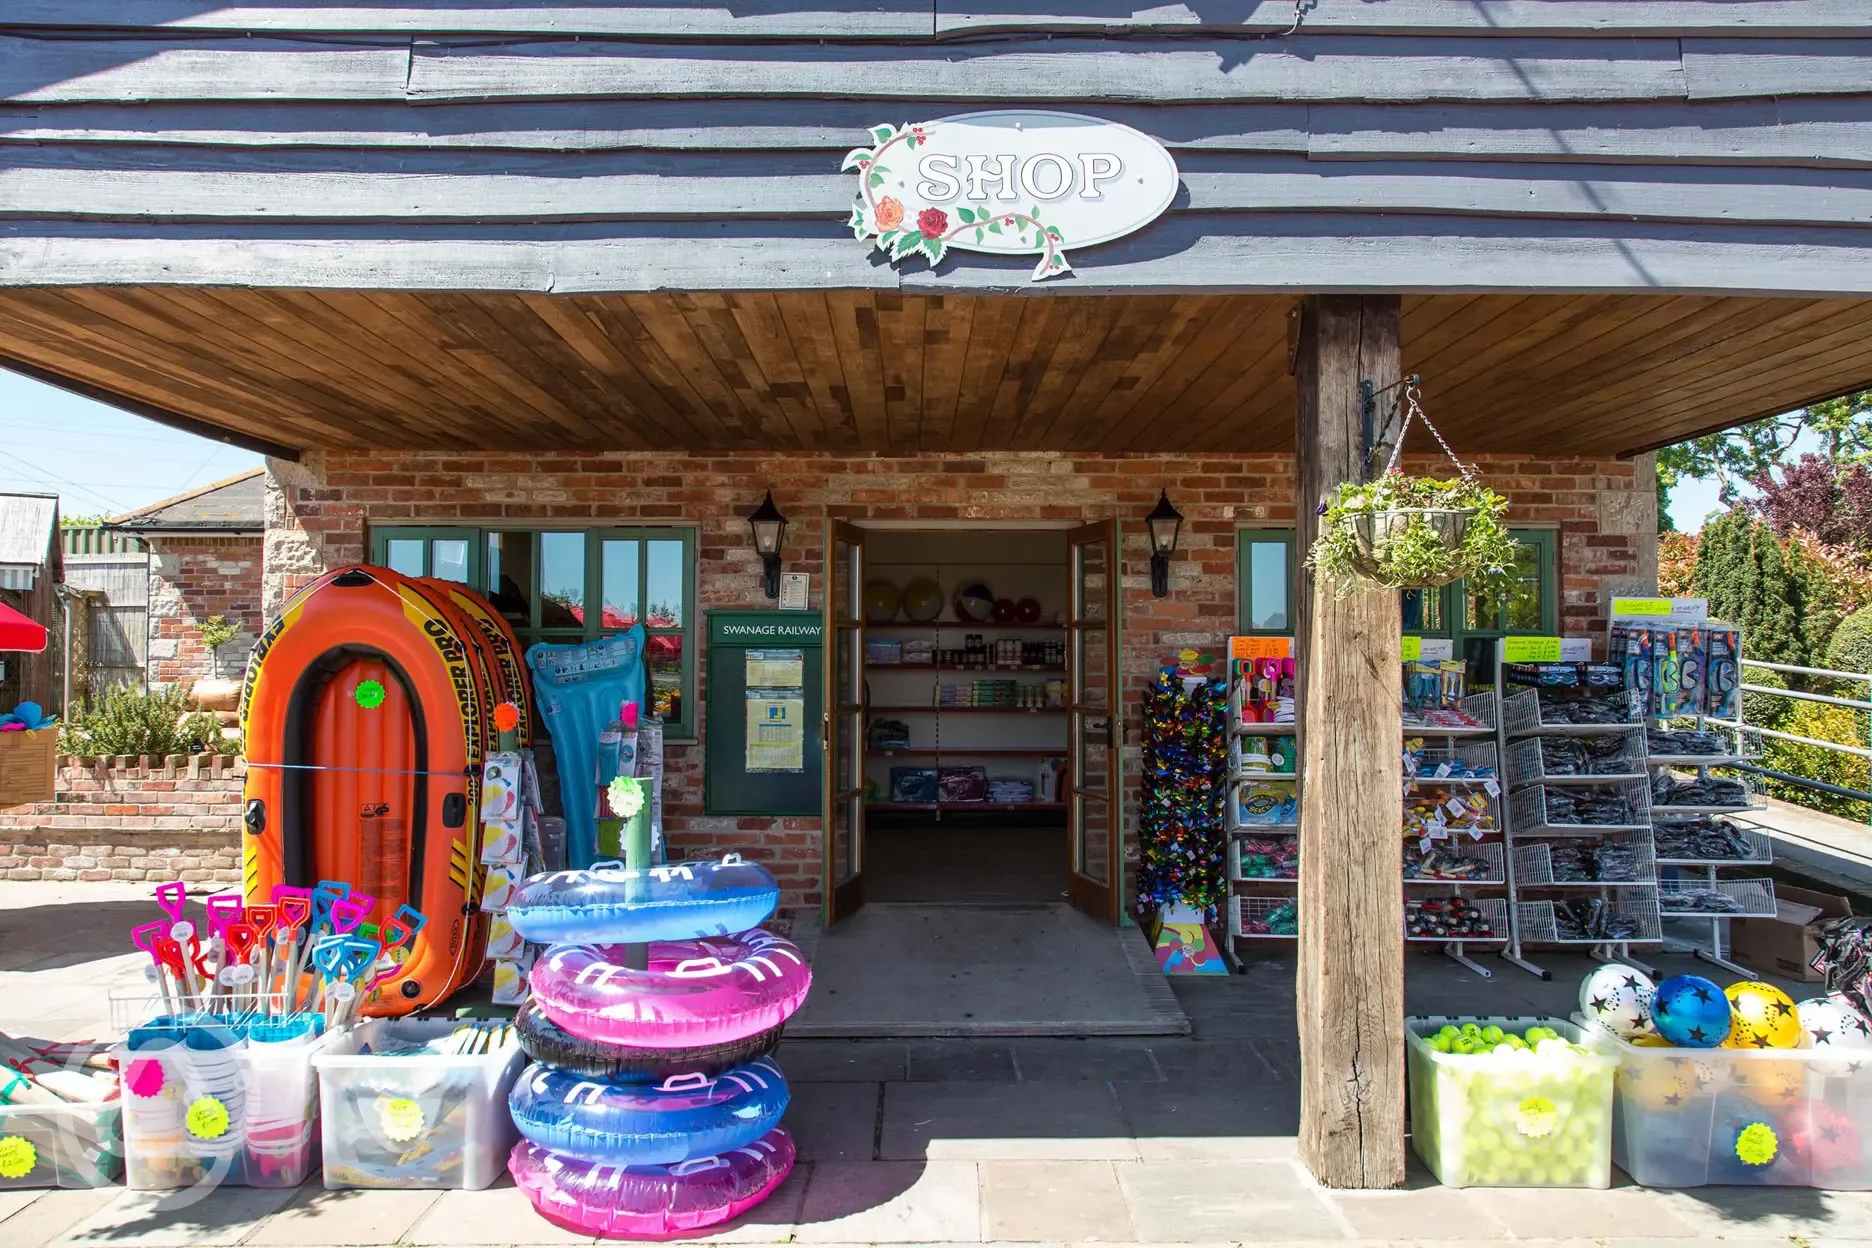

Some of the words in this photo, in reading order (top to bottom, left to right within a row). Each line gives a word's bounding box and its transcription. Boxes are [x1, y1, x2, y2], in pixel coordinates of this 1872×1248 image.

[915, 152, 1124, 202] SHOP
[424, 618, 463, 663] PRO
[723, 625, 775, 635] SWANAGE
[778, 625, 822, 636] RAILWAY
[450, 665, 480, 760] EXPLORER
